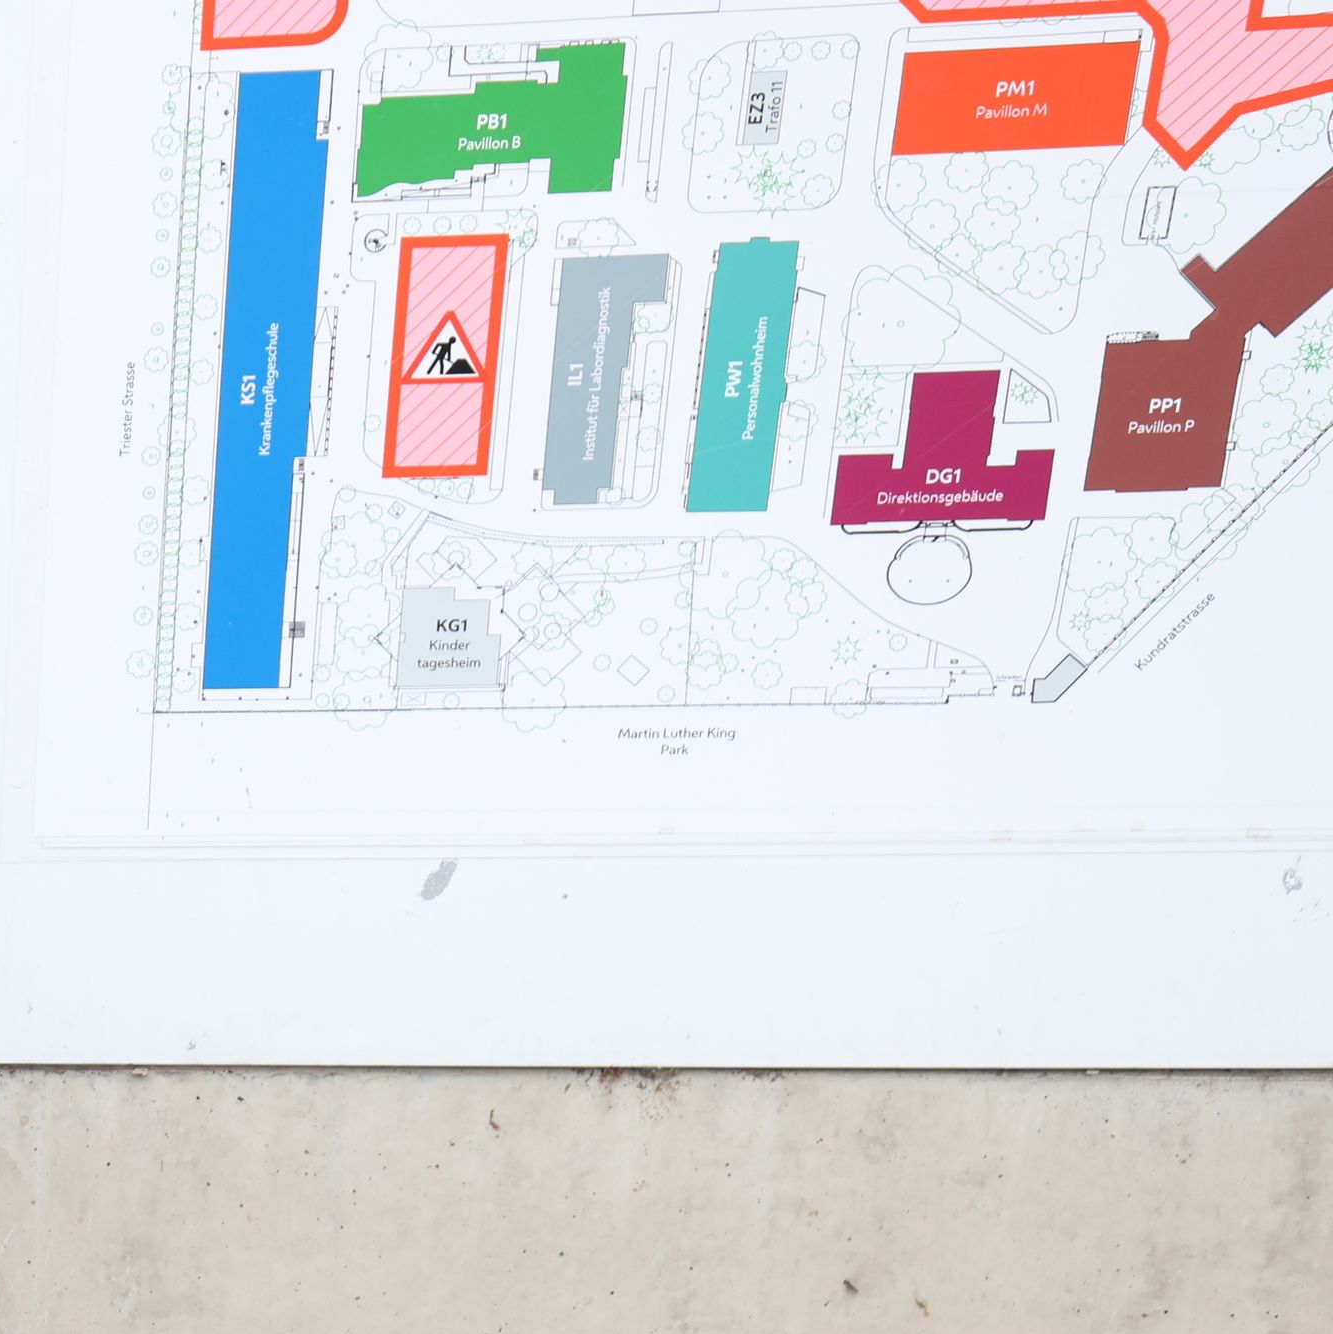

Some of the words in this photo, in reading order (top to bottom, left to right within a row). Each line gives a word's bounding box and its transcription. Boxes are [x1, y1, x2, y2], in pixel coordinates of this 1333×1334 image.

[771, 82, 783, 93] 11
[995, 80, 1035, 98] PM1
[748, 92, 766, 124] EZ3
[765, 97, 781, 133] Trafo
[975, 105, 1030, 119] Pavillon
[1033, 103, 1048, 117] M
[476, 113, 508, 130] PB1
[457, 136, 509, 151] Pavillon
[511, 135, 521, 149] B
[589, 286, 611, 392] Labordiagnostik
[567, 363, 583, 386] IL1
[725, 361, 743, 397] PW1
[742, 316, 768, 440] Personalwohnheim
[122, 362, 135, 406] Strasse
[240, 375, 257, 405] KS1
[258, 322, 279, 456] Krankenpflegeschule
[586, 394, 600, 414] für
[1149, 398, 1182, 414] PP1
[119, 410, 133, 457] Triester
[1127, 421, 1182, 434] Pavillon
[1184, 420, 1195, 433] P
[582, 415, 598, 461] Institut
[925, 468, 962, 484] DG1
[877, 490, 1004, 506] Direktionsgebäude
[436, 618, 468, 632] KG1
[1134, 593, 1215, 671] Kundratstrasse
[429, 640, 471, 651] Kinder
[417, 656, 481, 671] tagesheim
[618, 728, 660, 739] Martin
[663, 727, 704, 739] Luther
[707, 727, 736, 741] King
[661, 744, 689, 755] Park
